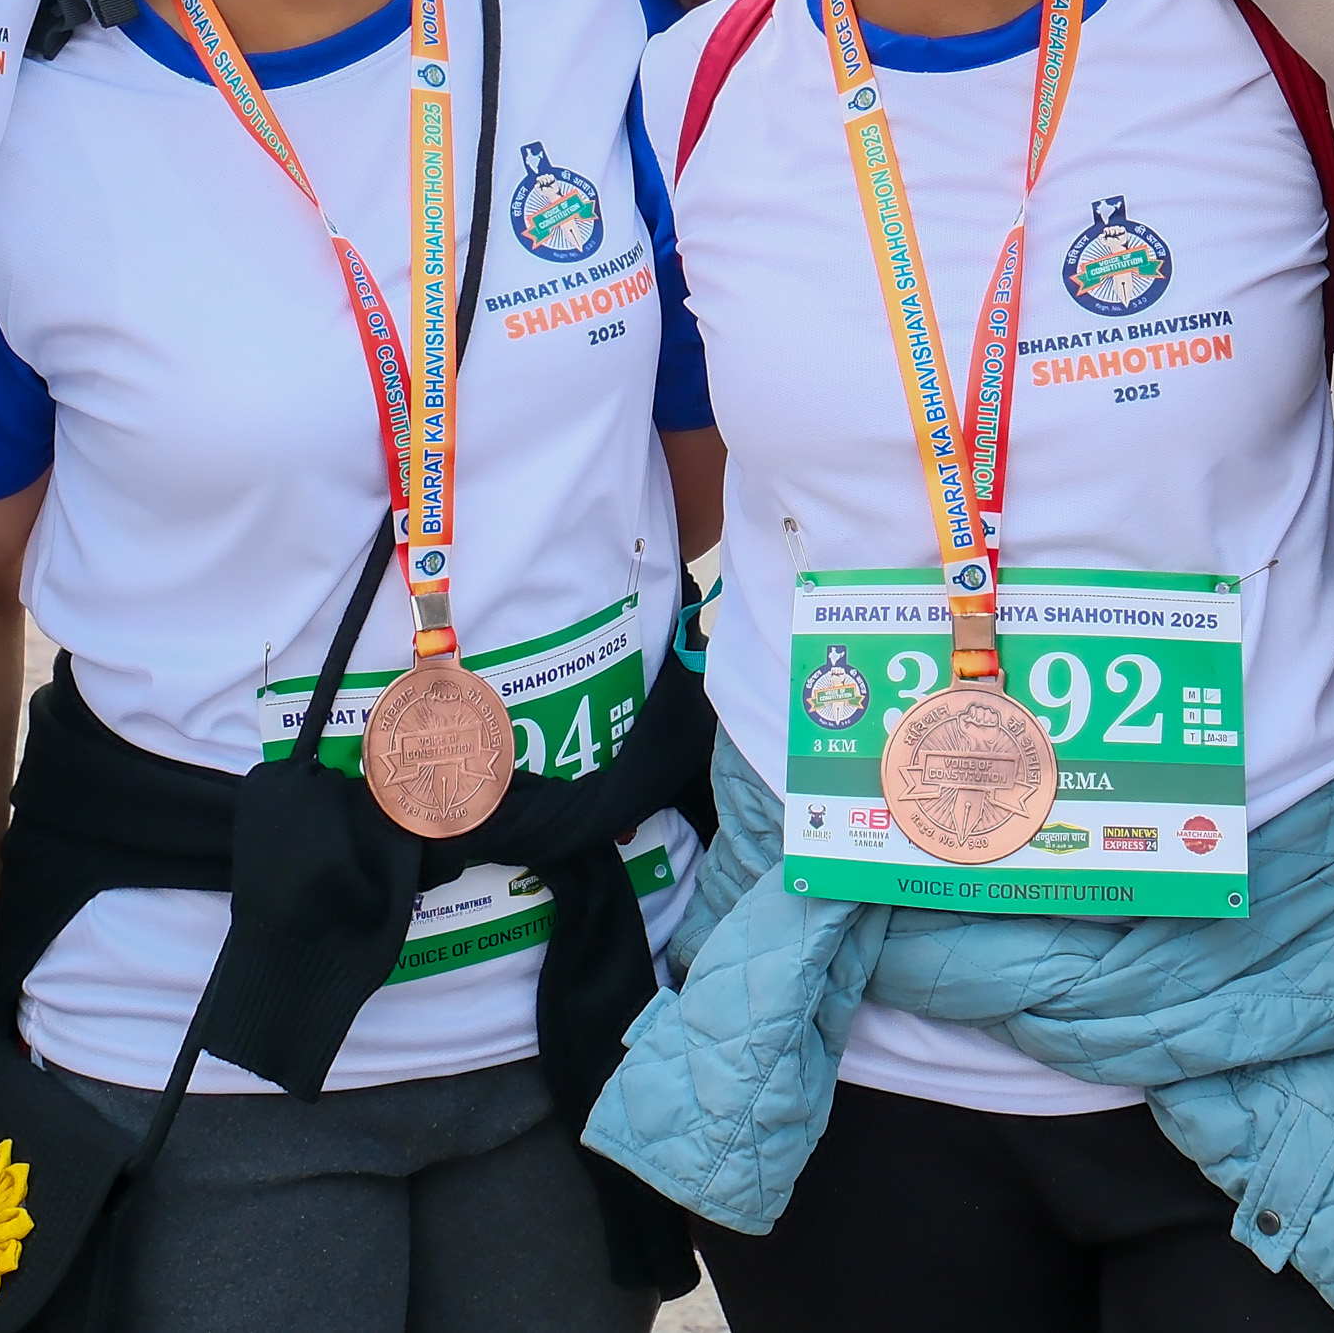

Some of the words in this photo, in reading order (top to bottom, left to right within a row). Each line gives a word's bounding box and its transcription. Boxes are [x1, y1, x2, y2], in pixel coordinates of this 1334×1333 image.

[835, 16, 863, 78] VOICE
[1037, 13, 1068, 133] SHAHOTHON
[214, 51, 288, 160] SHAHOTHON
[424, 103, 442, 146] 2025
[860, 123, 888, 167] 2025
[424, 151, 445, 276] SHAHOTHON
[870, 168, 918, 292] SHAHOTHON
[485, 279, 559, 312] BHARAT
[561, 271, 588, 291] KA
[588, 241, 644, 282] BHAVISHYA
[992, 241, 1018, 305] VOICE
[1090, 257, 1144, 276] CONSTITUTION
[345, 249, 378, 308] VOICE
[368, 311, 390, 340] OF
[504, 264, 654, 340] SHAHOTHON
[424, 280, 446, 409] BHAVISHAYA
[588, 320, 626, 346] 2025
[987, 309, 1008, 338] OF
[1018, 332, 1093, 356] BHARAT
[1097, 328, 1124, 345] KA
[1128, 310, 1234, 340] BHAVISHYA
[899, 292, 947, 424] BHAVISHAYA
[1031, 334, 1234, 387] SHAHOTHON
[1113, 382, 1161, 404] 2025
[424, 413, 445, 445] KA
[930, 424, 957, 458] KA
[422, 449, 445, 534] BHARAT
[937, 462, 976, 550] BHARAT
[815, 606, 891, 623] BHARAT
[896, 606, 923, 623] KA
[1044, 607, 1165, 627] SHAHOTHON
[1170, 612, 1218, 629] 2025
[501, 651, 596, 697] SHAHOTHON
[599, 633, 627, 661] 2025
[282, 709, 356, 728] BHRAT
[883, 650, 1164, 745] 392
[406, 743, 474, 761] CONSTITUTION
[813, 739, 822, 752] 3
[827, 739, 857, 753] KM
[944, 758, 976, 770] VOICE
[978, 760, 994, 771] OF
[929, 768, 1007, 783] CONSTITUTION
[1058, 772, 1114, 790] RMA
[450, 809, 467, 822] 540
[1104, 827, 1130, 838] INDIA
[1131, 828, 1158, 838] NEWS
[967, 837, 989, 849] 540
[1104, 841, 1144, 851] EXPRESS
[1146, 840, 1157, 851] 24
[416, 905, 454, 920] POLITICAL
[455, 896, 493, 912] PARTNERS
[897, 878, 954, 897] VOICE
[959, 882, 983, 899] OF
[987, 883, 1134, 902] CONSTITUTION
[397, 947, 449, 970] VOICE
[452, 940, 474, 957] OF
[477, 914, 557, 951] CONSTITU
